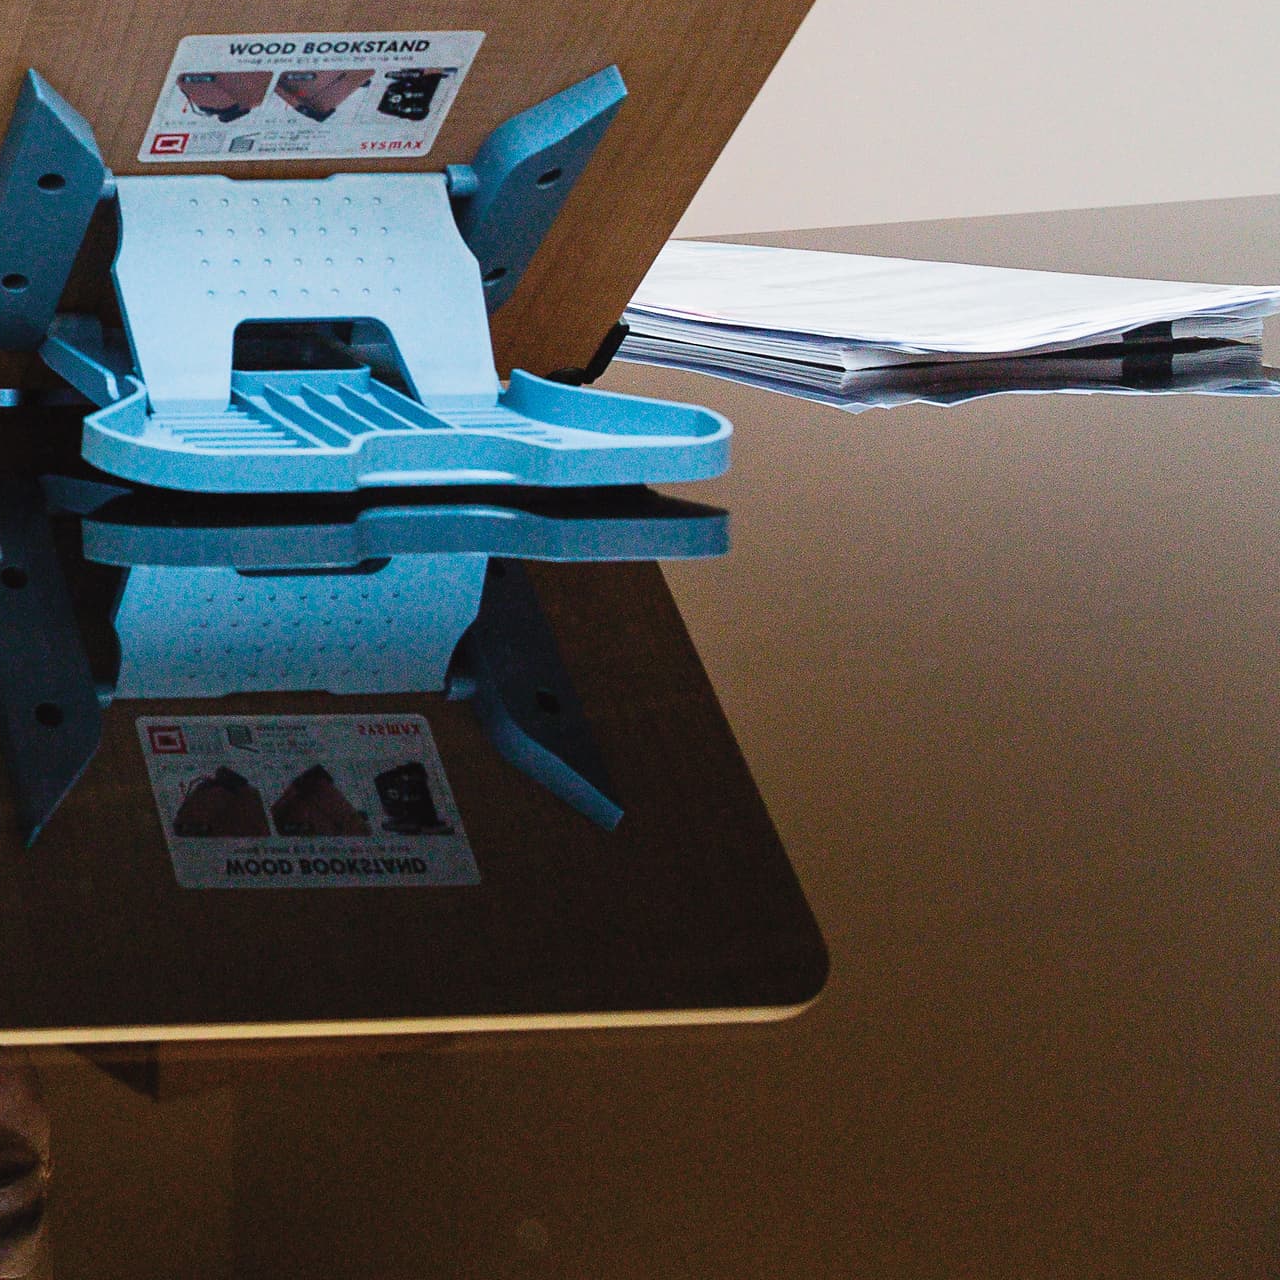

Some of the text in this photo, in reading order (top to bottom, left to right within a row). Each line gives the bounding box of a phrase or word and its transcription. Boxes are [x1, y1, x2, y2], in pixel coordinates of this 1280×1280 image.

[230, 39, 430, 56] WOOD BOOKSTAND
[360, 140, 423, 151] SYSMAX
